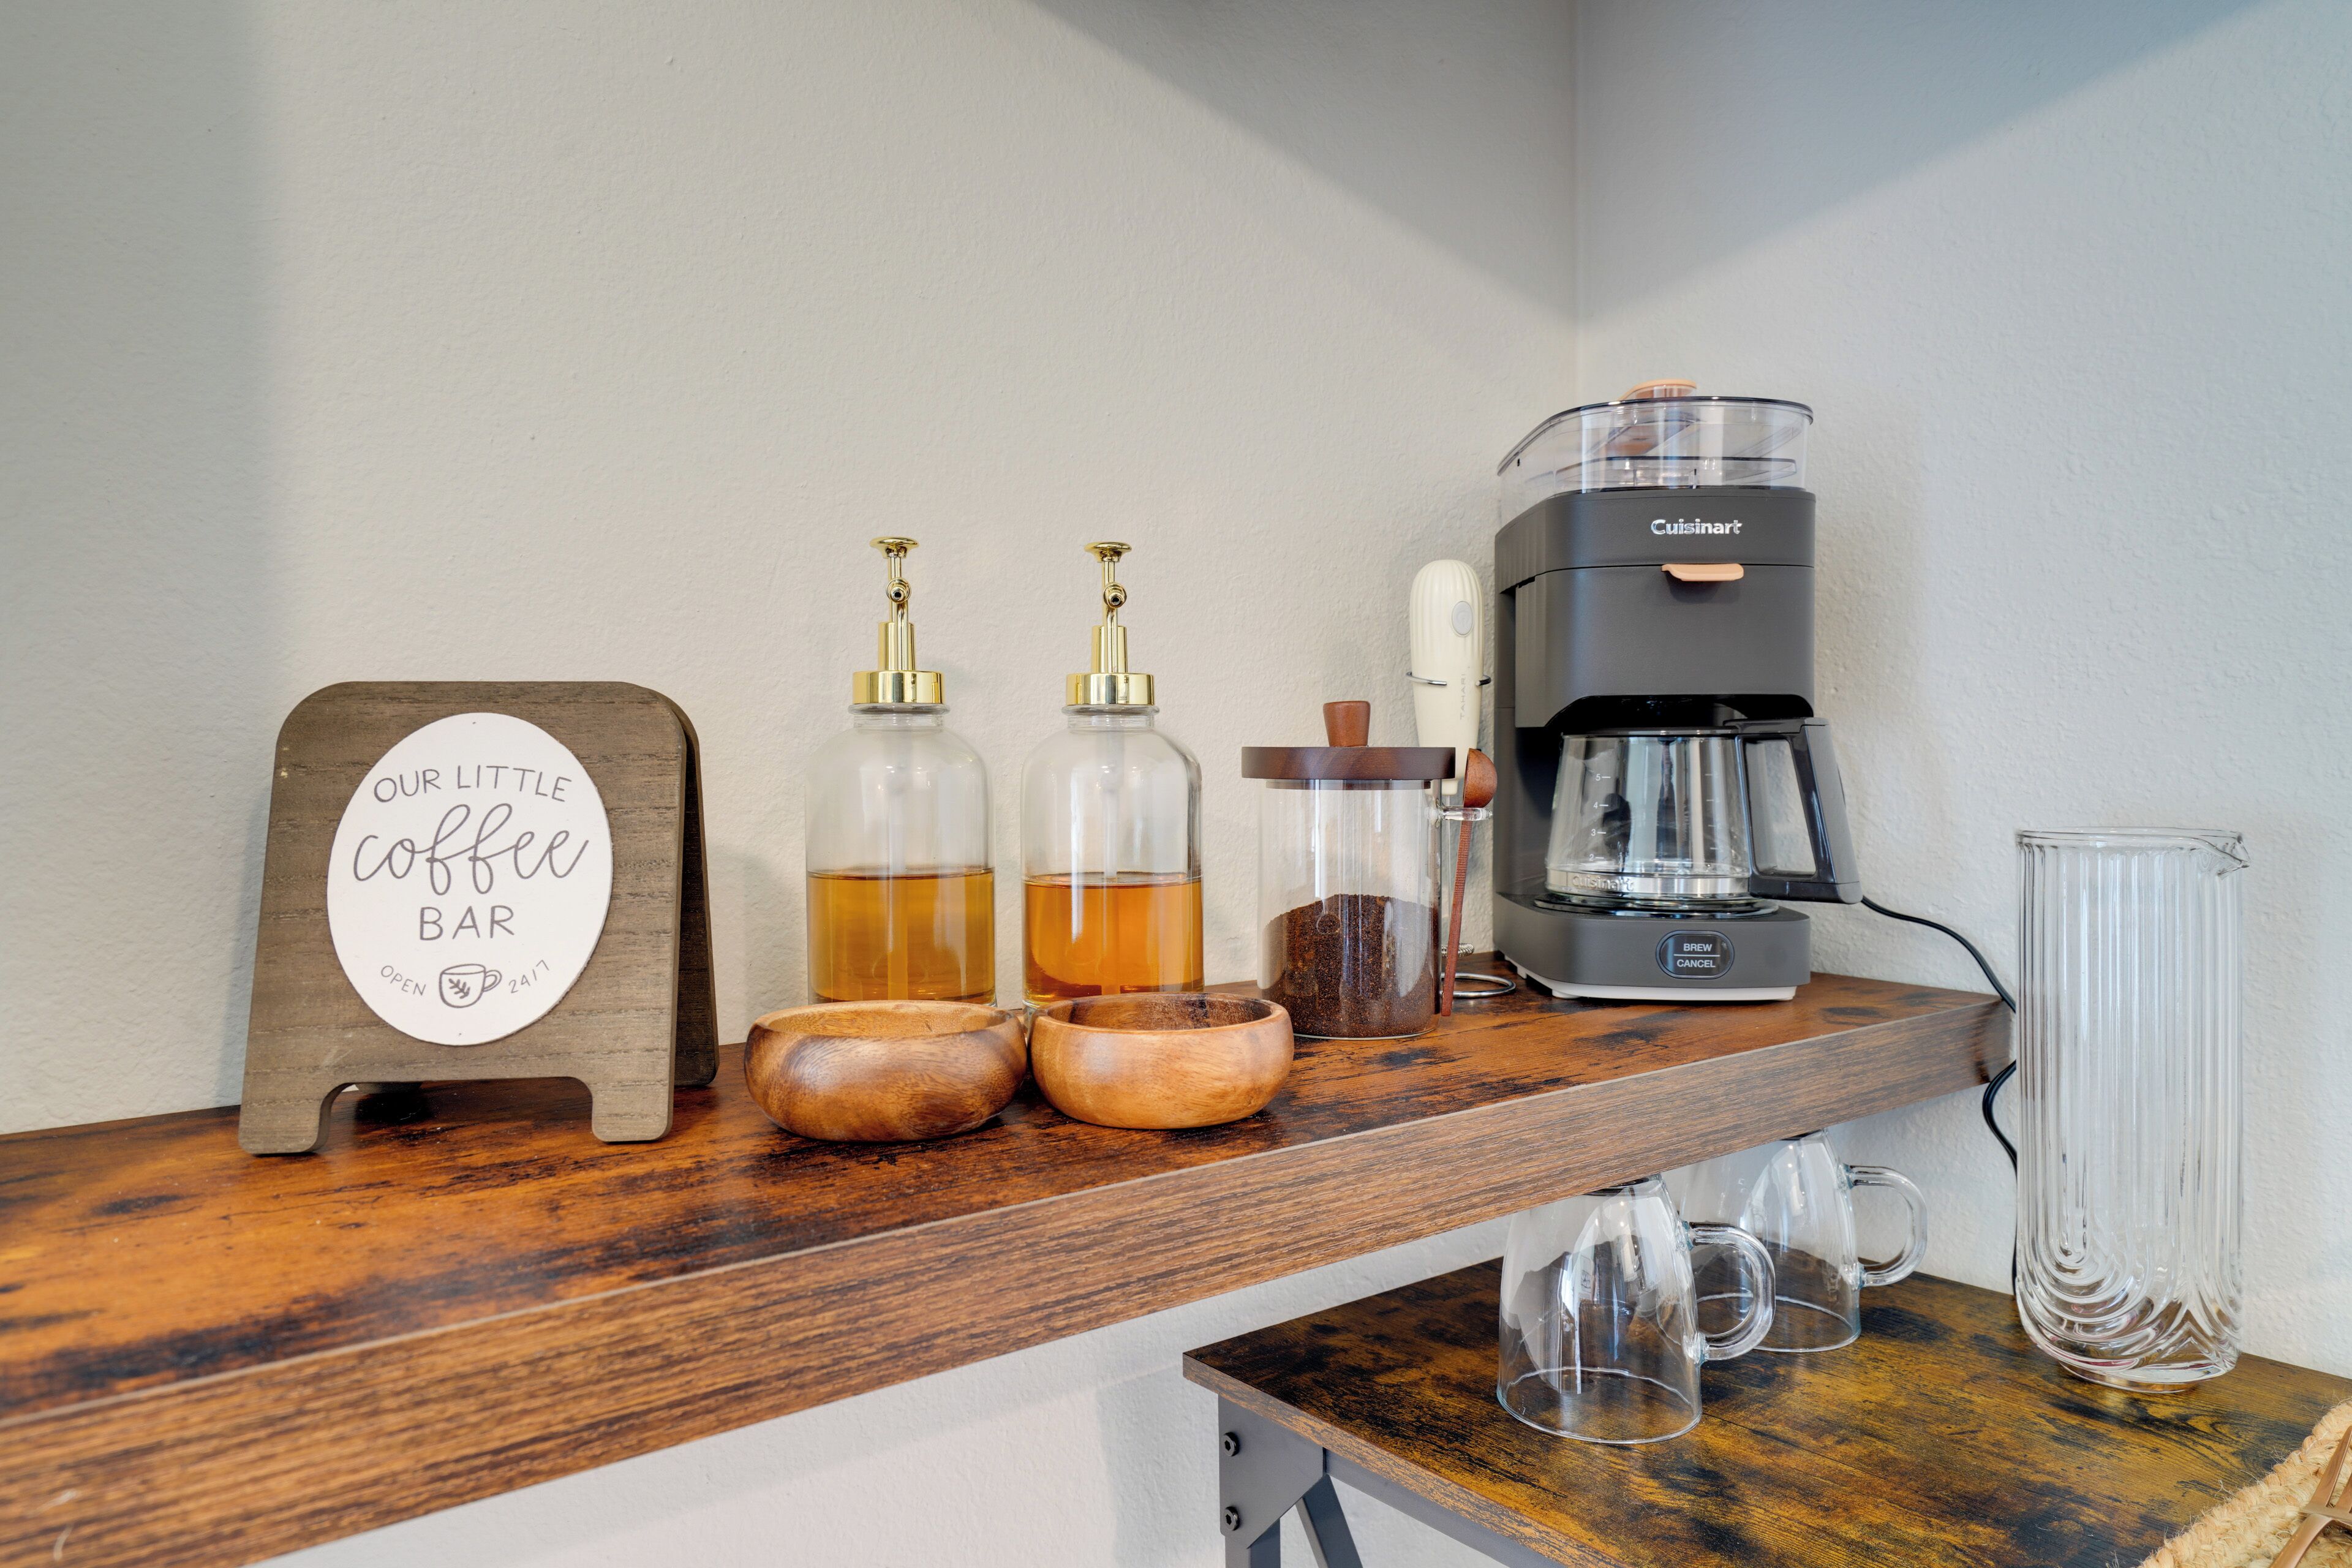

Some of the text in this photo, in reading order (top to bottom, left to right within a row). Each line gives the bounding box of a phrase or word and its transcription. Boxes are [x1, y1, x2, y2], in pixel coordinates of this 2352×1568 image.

[1651, 518, 1743, 535] Cuisinart
[374, 764, 572, 803] OUR LITTLE
[353, 803, 590, 896] coffee
[420, 905, 514, 941] BAR
[1676, 959, 1716, 968] CANCEL
[1683, 943, 1713, 952] BREW
[380, 959, 549, 996] OPEN 24/7
